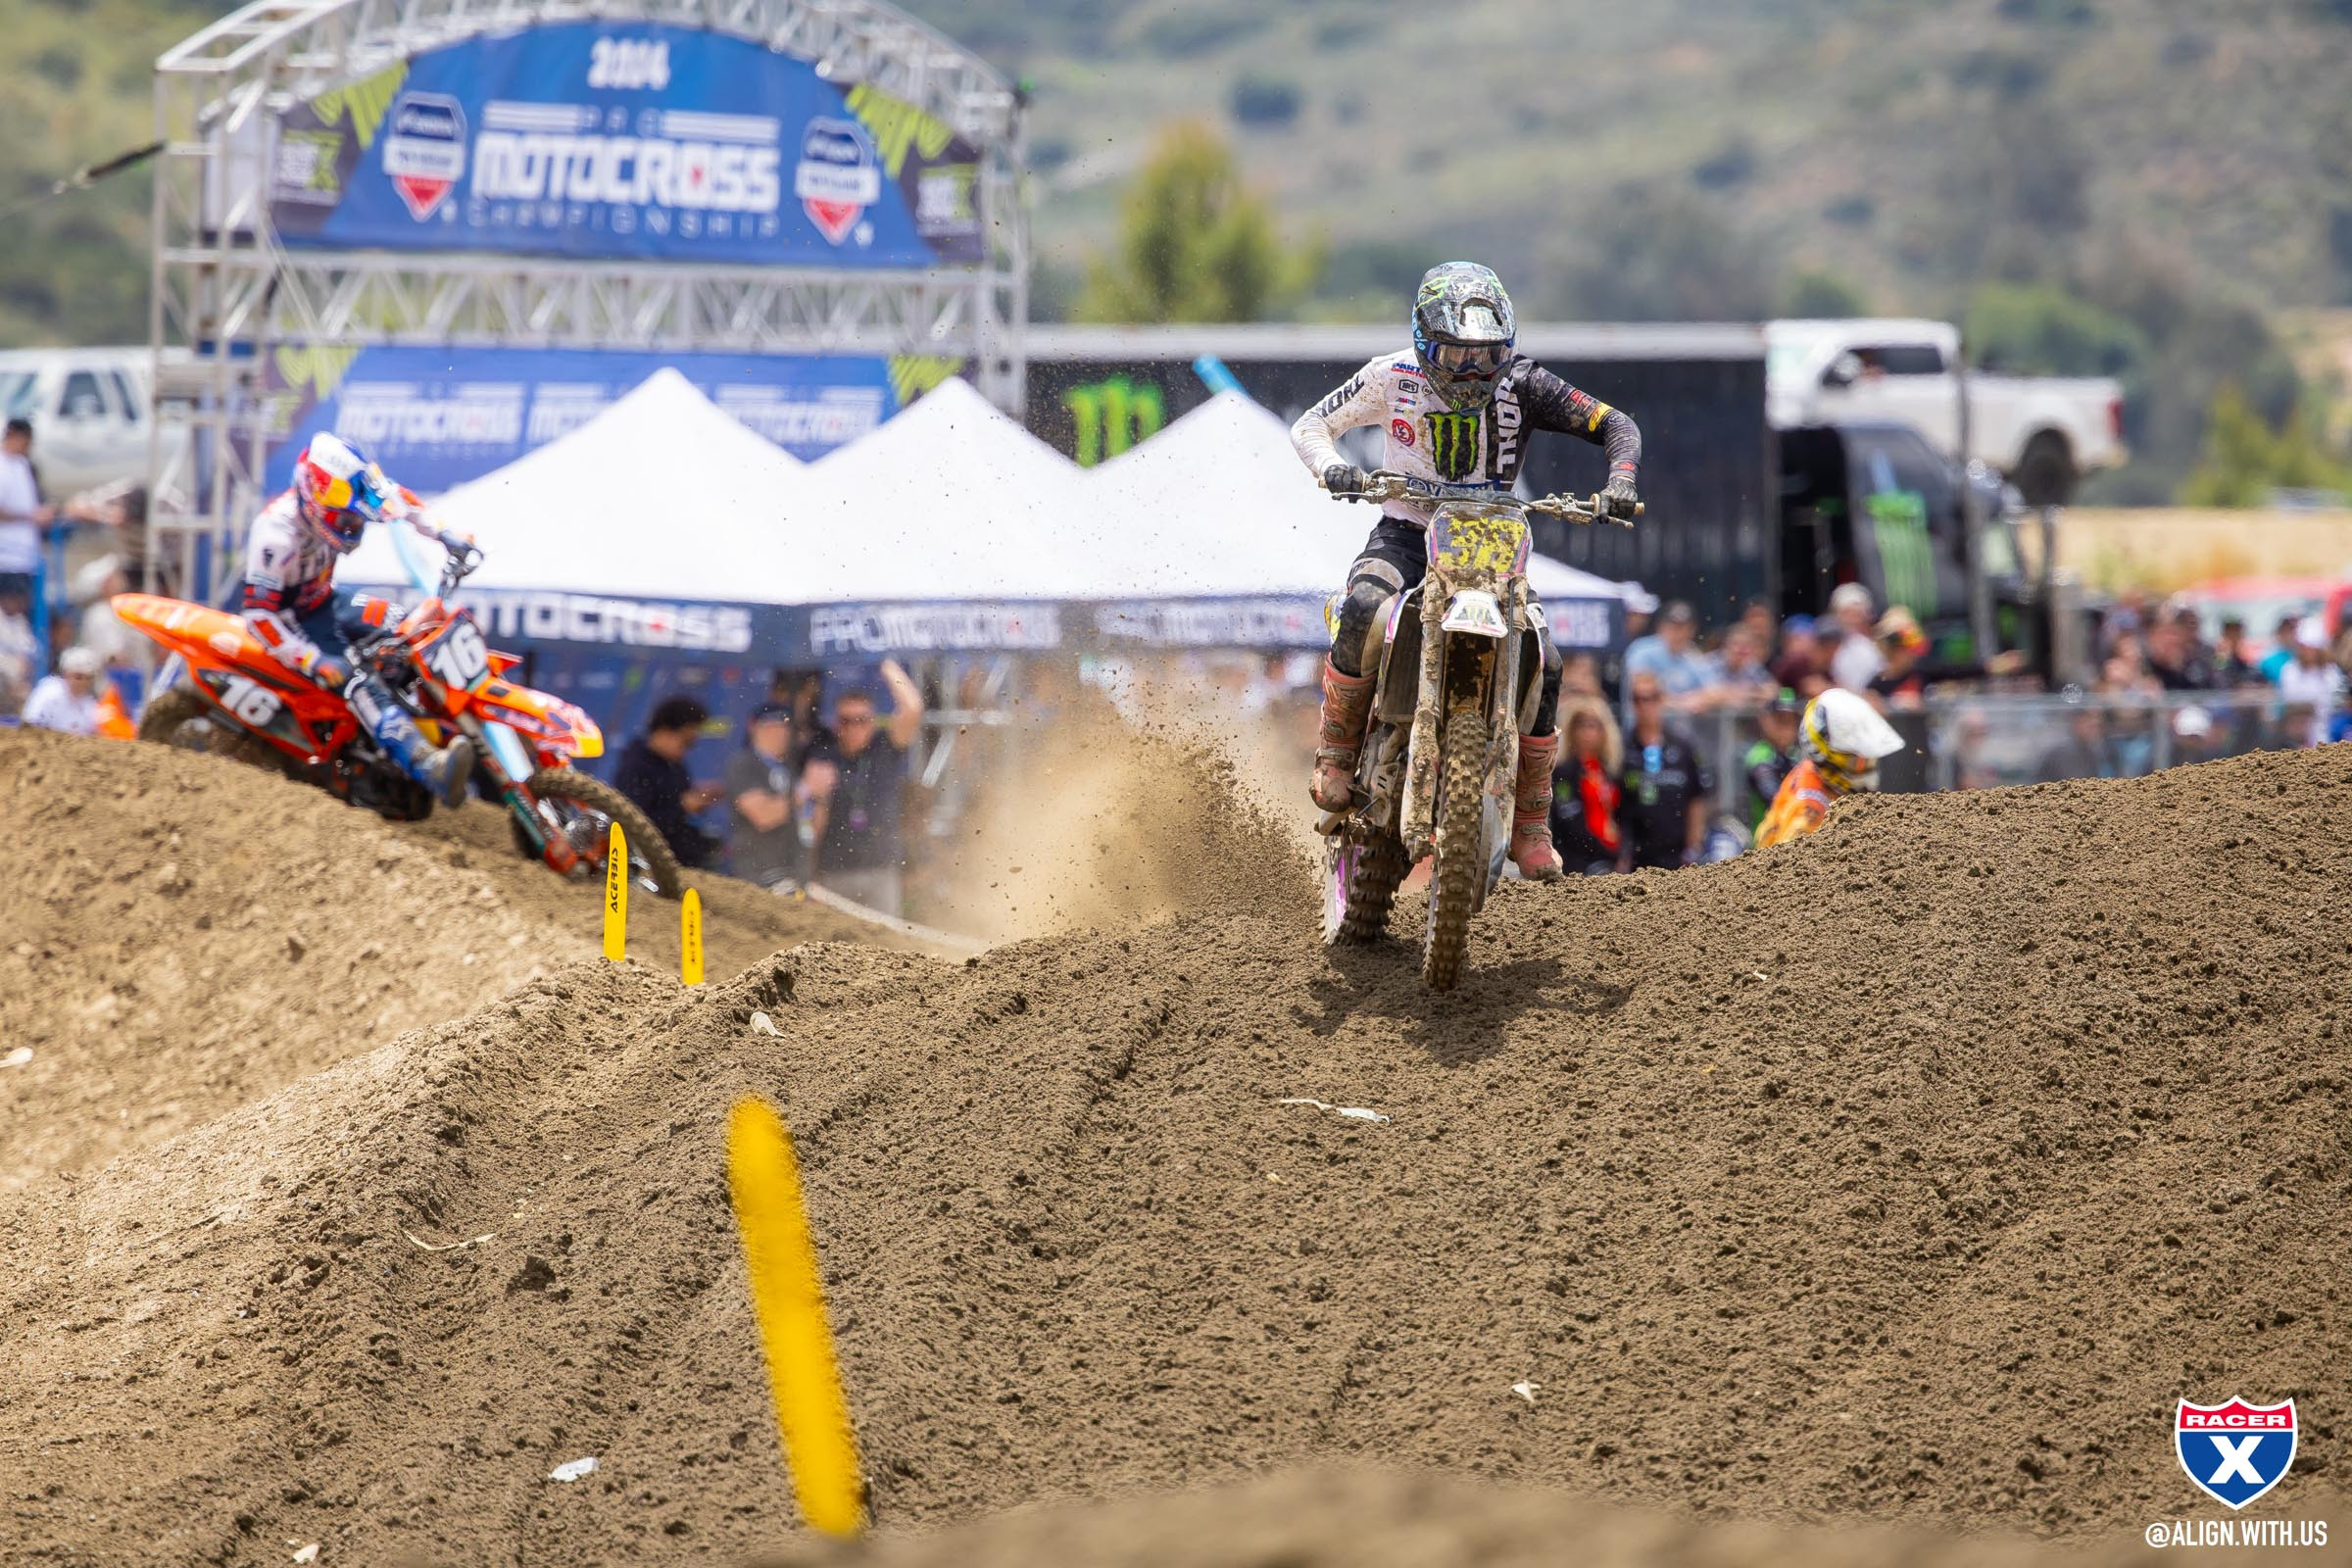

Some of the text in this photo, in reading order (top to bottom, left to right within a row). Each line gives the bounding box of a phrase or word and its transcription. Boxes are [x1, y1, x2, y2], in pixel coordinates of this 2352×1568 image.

[472, 130, 781, 213] MOTOCROSS
[1392, 362, 1424, 372] PART
[1494, 376, 1523, 474] THOR
[446, 588, 753, 653] OTOCROSS
[431, 621, 488, 690] 16
[220, 674, 282, 727] 16
[610, 847, 618, 913] ACERBIS
